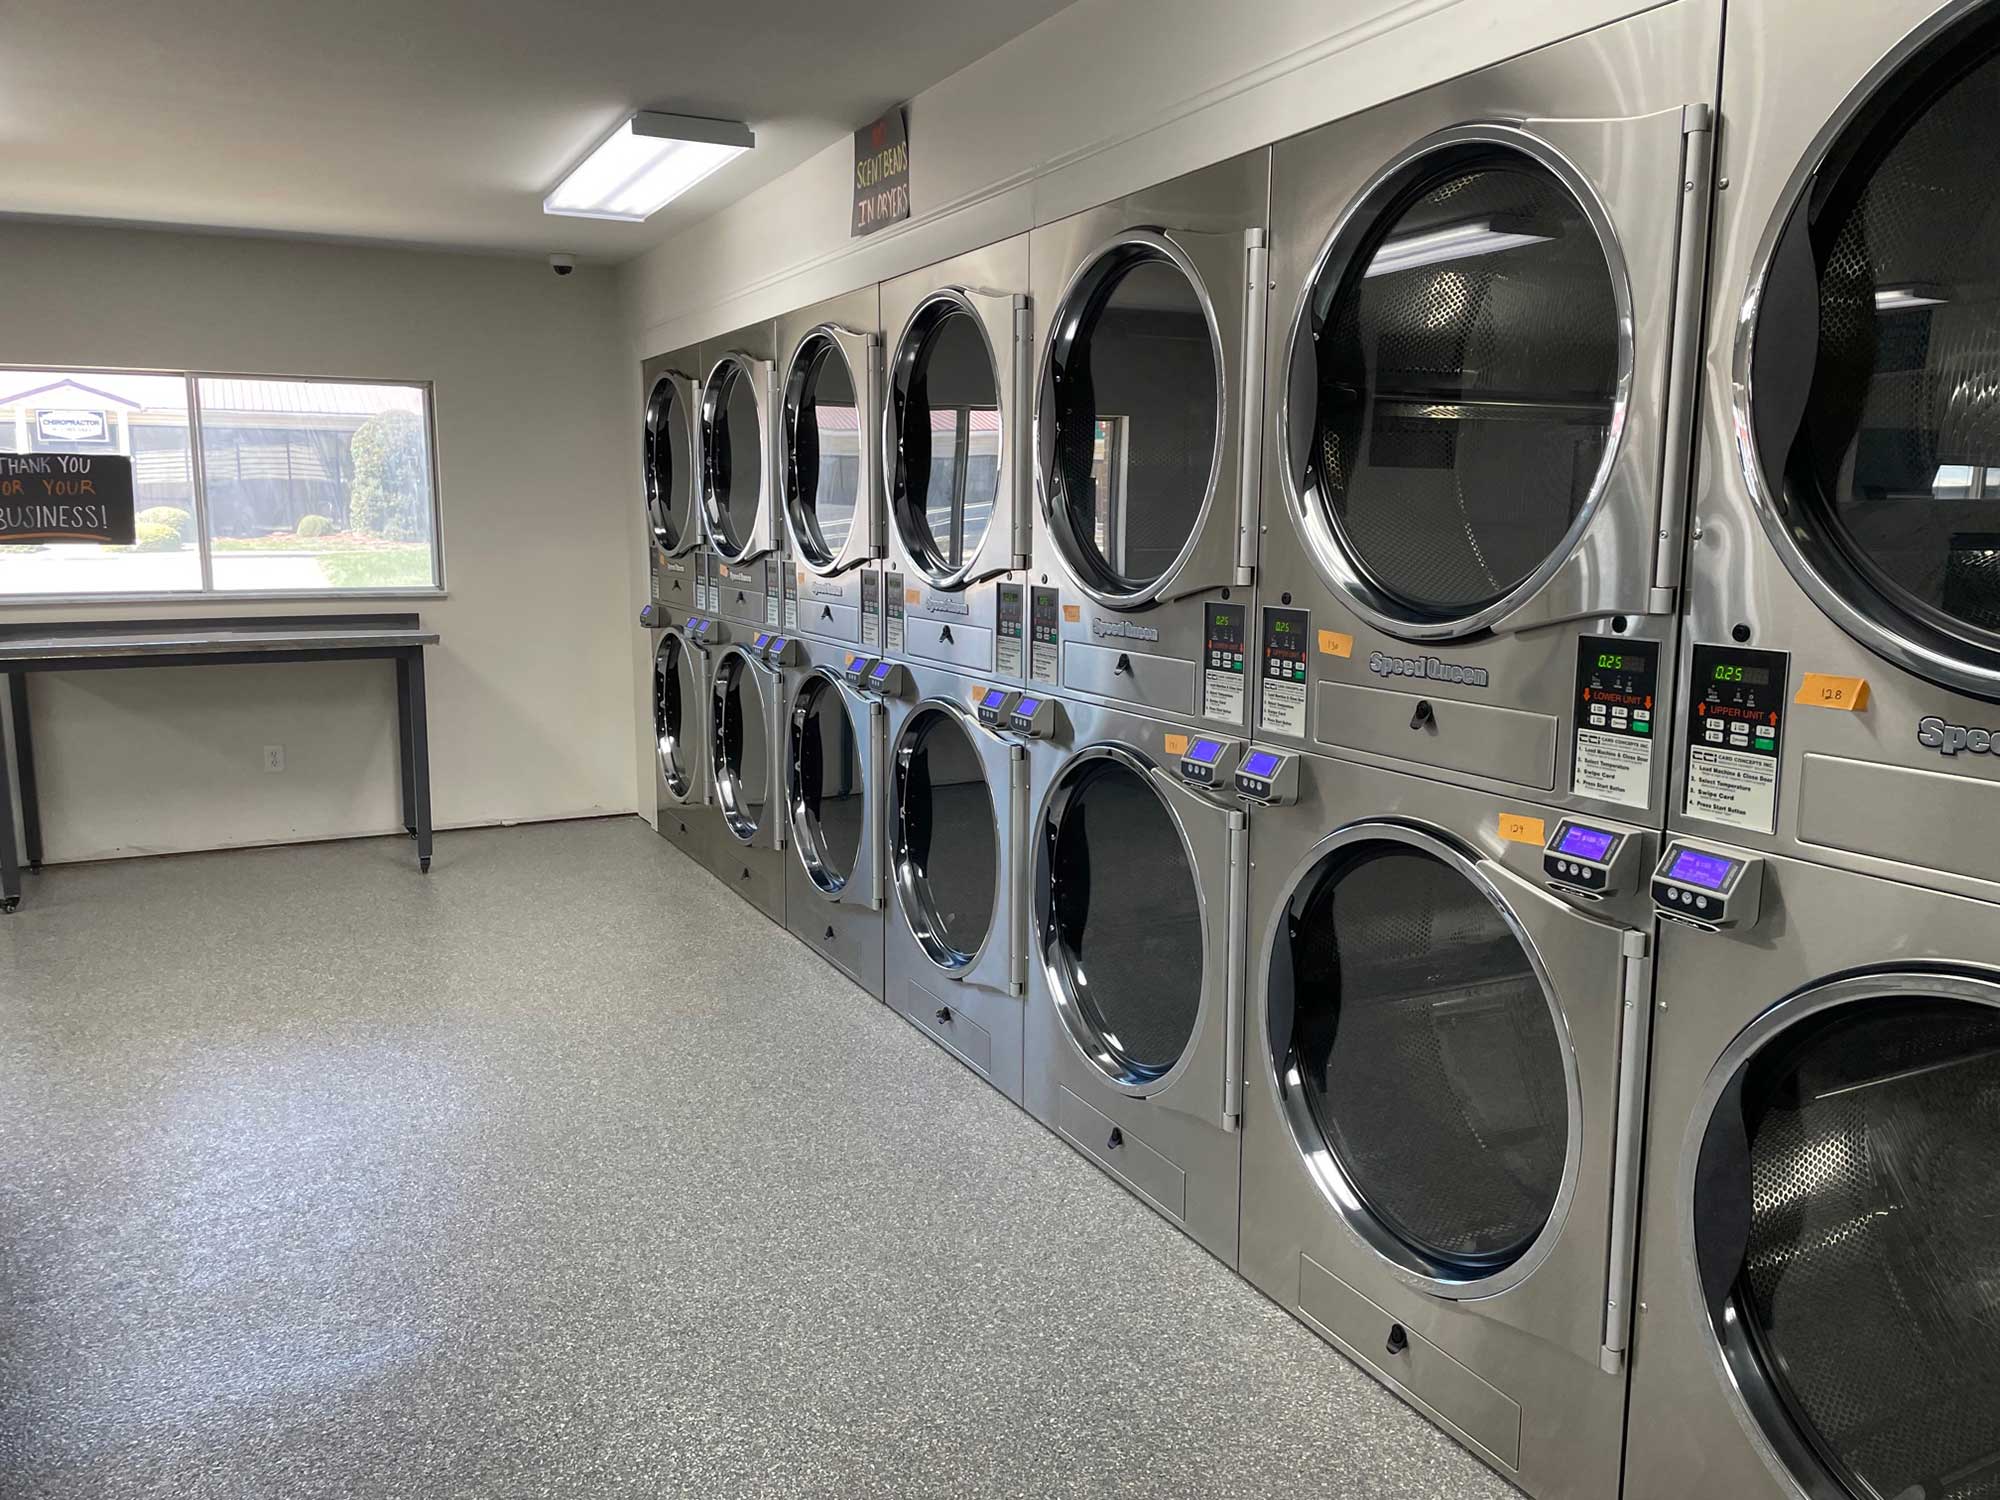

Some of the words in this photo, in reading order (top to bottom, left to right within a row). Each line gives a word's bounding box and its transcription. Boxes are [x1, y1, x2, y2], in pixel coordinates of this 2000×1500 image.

[857, 153, 882, 189] SCENT
[883, 142, 907, 178] BEADS
[858, 197, 874, 227] IN
[877, 184, 908, 220] DRYERS
[57, 456, 91, 473] YOU
[42, 479, 97, 495] YOUR
[1370, 651, 1426, 678] Speed
[1427, 656, 1488, 687] Queen
[1593, 691, 1621, 702] LOWER
[1623, 695, 1641, 704] UNIT
[1821, 687, 1842, 700] 128
[1710, 705, 1740, 716] UPPER
[1743, 710, 1764, 720] UNIT
[1714, 768, 1735, 776] Machine
[1699, 777, 1716, 785] Select
[1717, 780, 1751, 792] Temperature
[1698, 789, 1717, 798] Swipe
[1713, 804, 1726, 812] Start
[1728, 807, 1746, 815] Button
